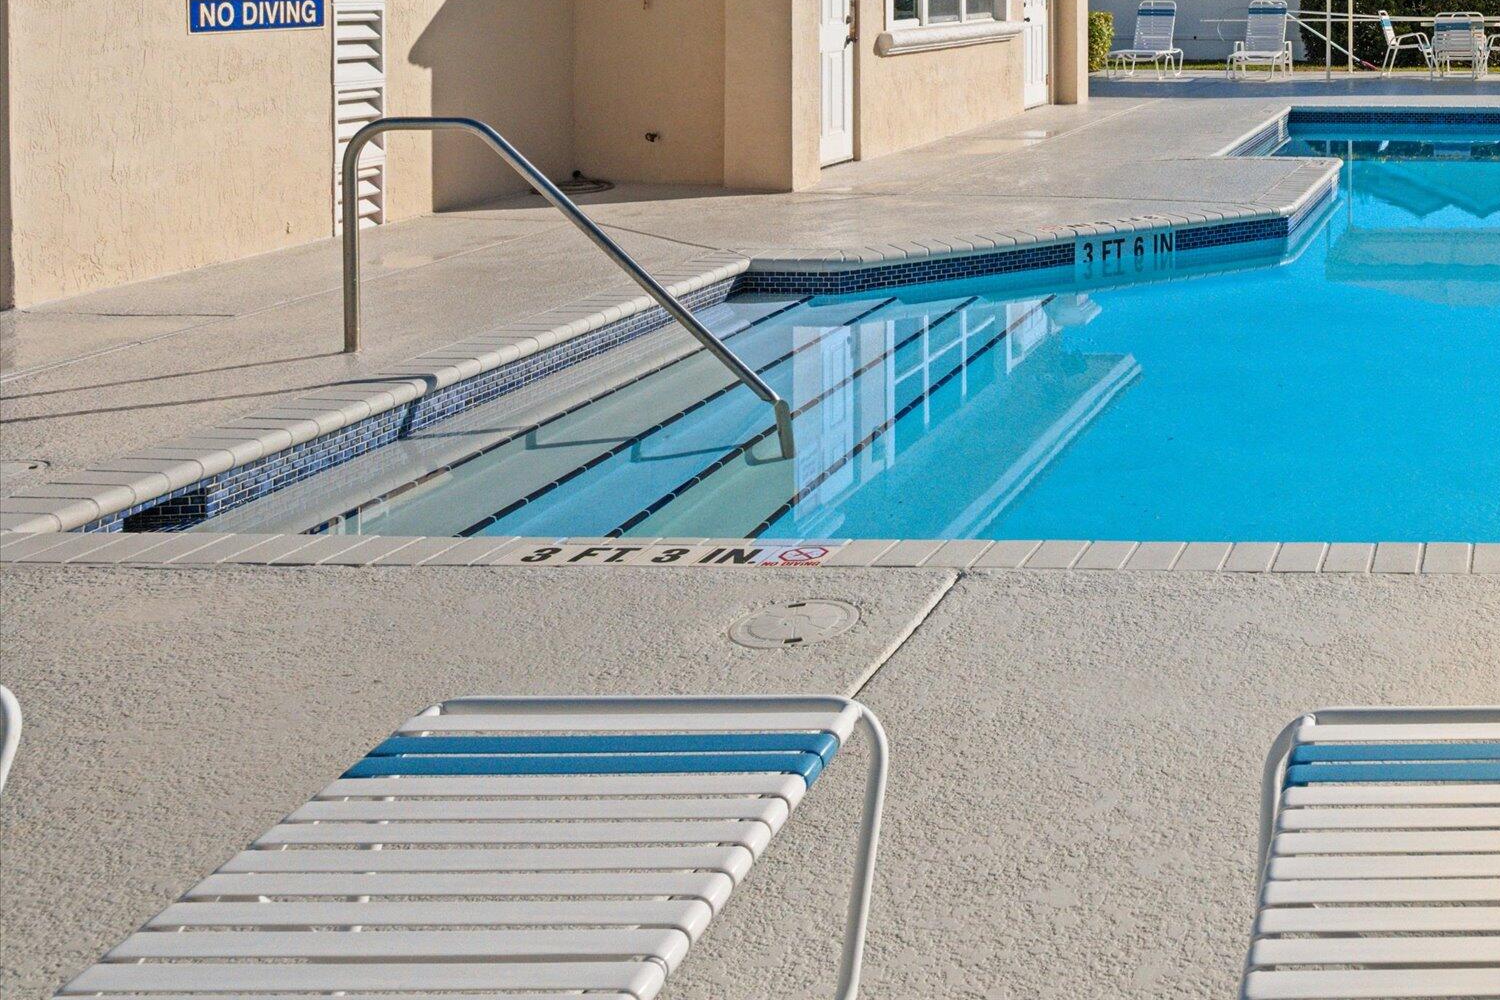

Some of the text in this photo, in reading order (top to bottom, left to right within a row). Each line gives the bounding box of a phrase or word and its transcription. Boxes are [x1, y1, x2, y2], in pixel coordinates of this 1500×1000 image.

[200, 0, 316, 27] NO DIVING
[1083, 232, 1173, 263] 3 FT 6 IN
[520, 547, 764, 564] 3 FT. 3 IN.
